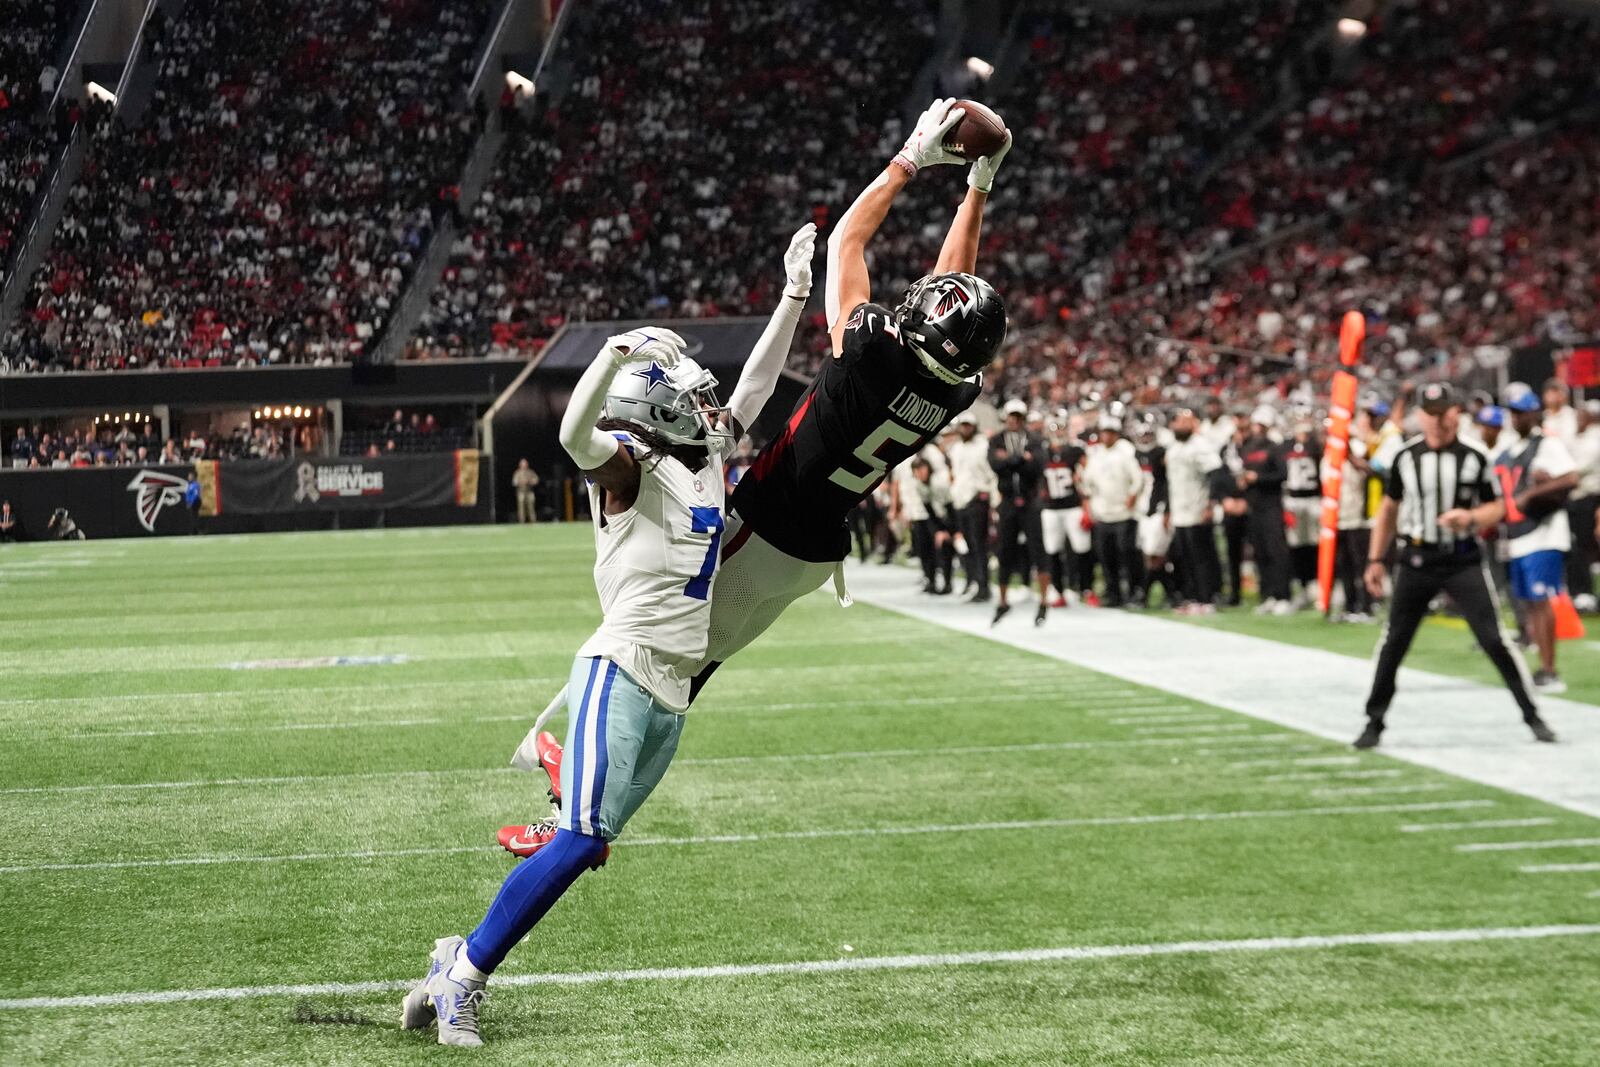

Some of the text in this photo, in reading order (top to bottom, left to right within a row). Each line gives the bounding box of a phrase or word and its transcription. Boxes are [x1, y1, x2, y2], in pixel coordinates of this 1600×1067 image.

[954, 362, 970, 373] 5
[887, 385, 948, 432] LONDON
[827, 418, 922, 494] 5
[317, 471, 384, 491] SERVICE
[1043, 467, 1074, 500] 12
[683, 506, 725, 601] 7
